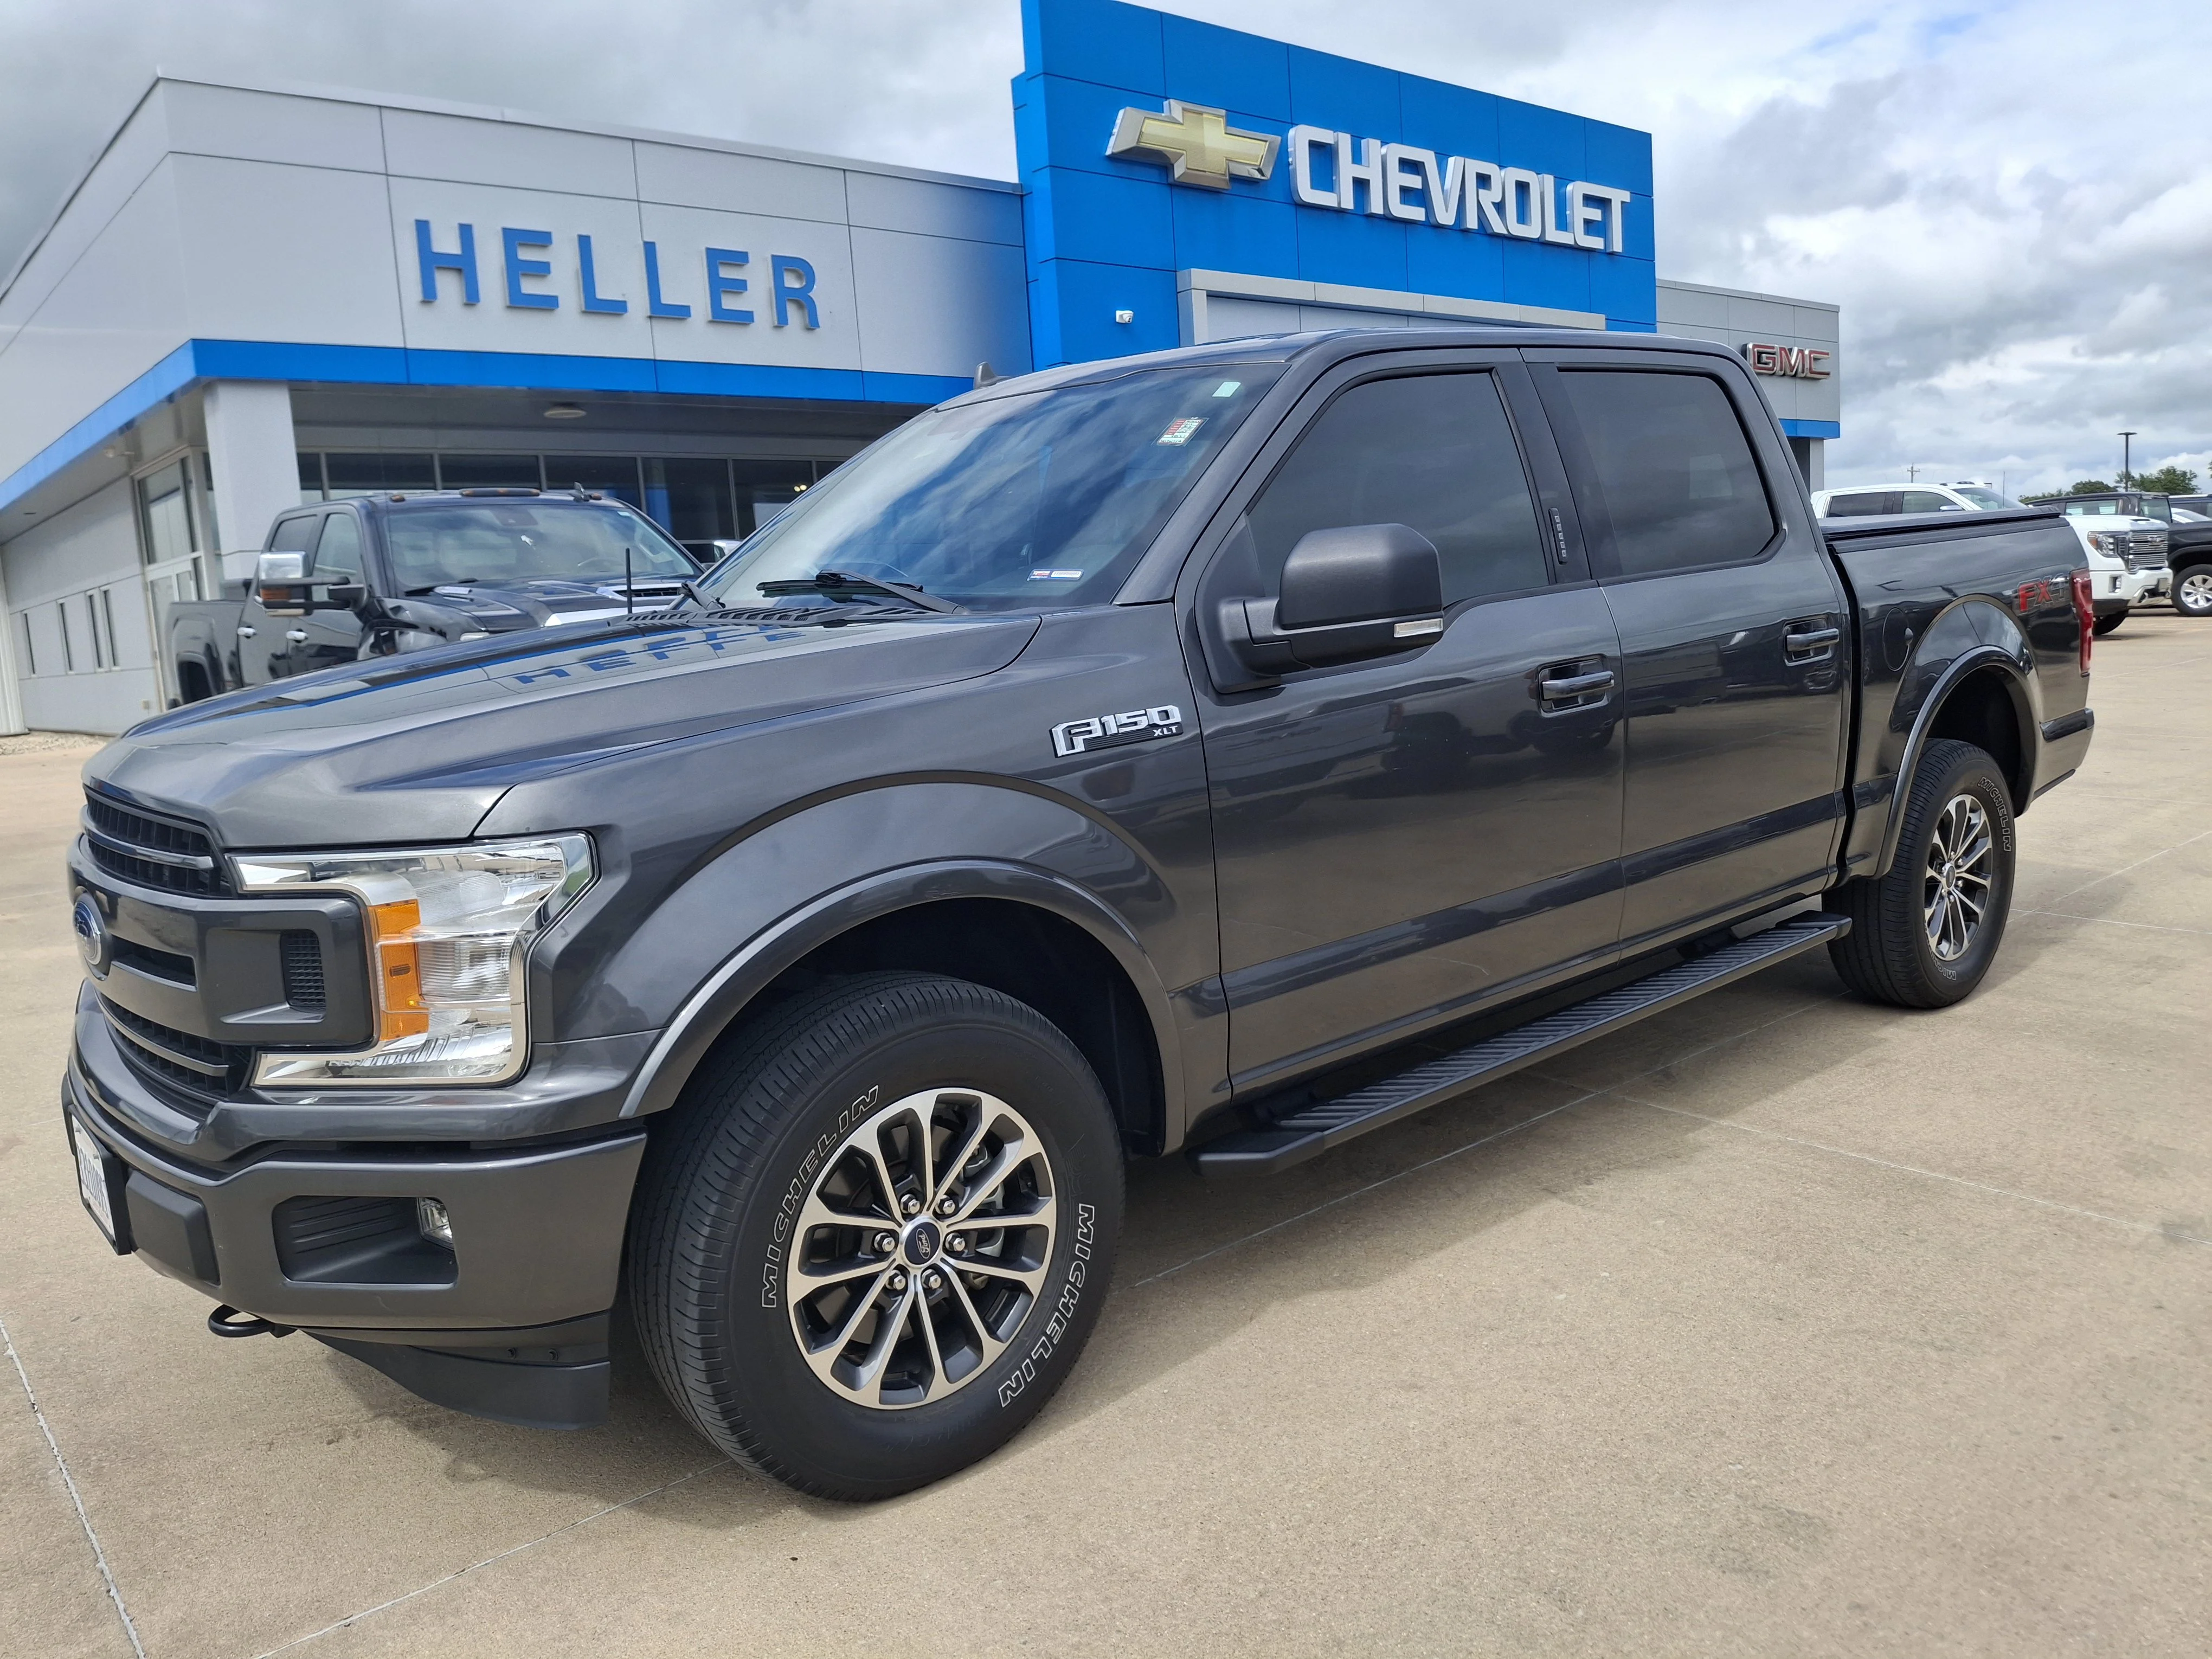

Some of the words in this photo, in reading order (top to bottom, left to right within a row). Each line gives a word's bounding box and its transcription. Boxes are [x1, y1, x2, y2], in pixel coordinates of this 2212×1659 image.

[1288, 124, 1630, 253] CHEVROLET
[415, 218, 820, 330] HELLER
[1745, 342, 1831, 380] GMC
[2017, 573, 2067, 615] FX4
[1153, 725, 1178, 737] XLT
[1977, 776, 2011, 852] MICHELIN
[760, 1084, 879, 1308] MICHELIN
[918, 1233, 929, 1253] Ford
[998, 1203, 1095, 1408] MICHELIN
